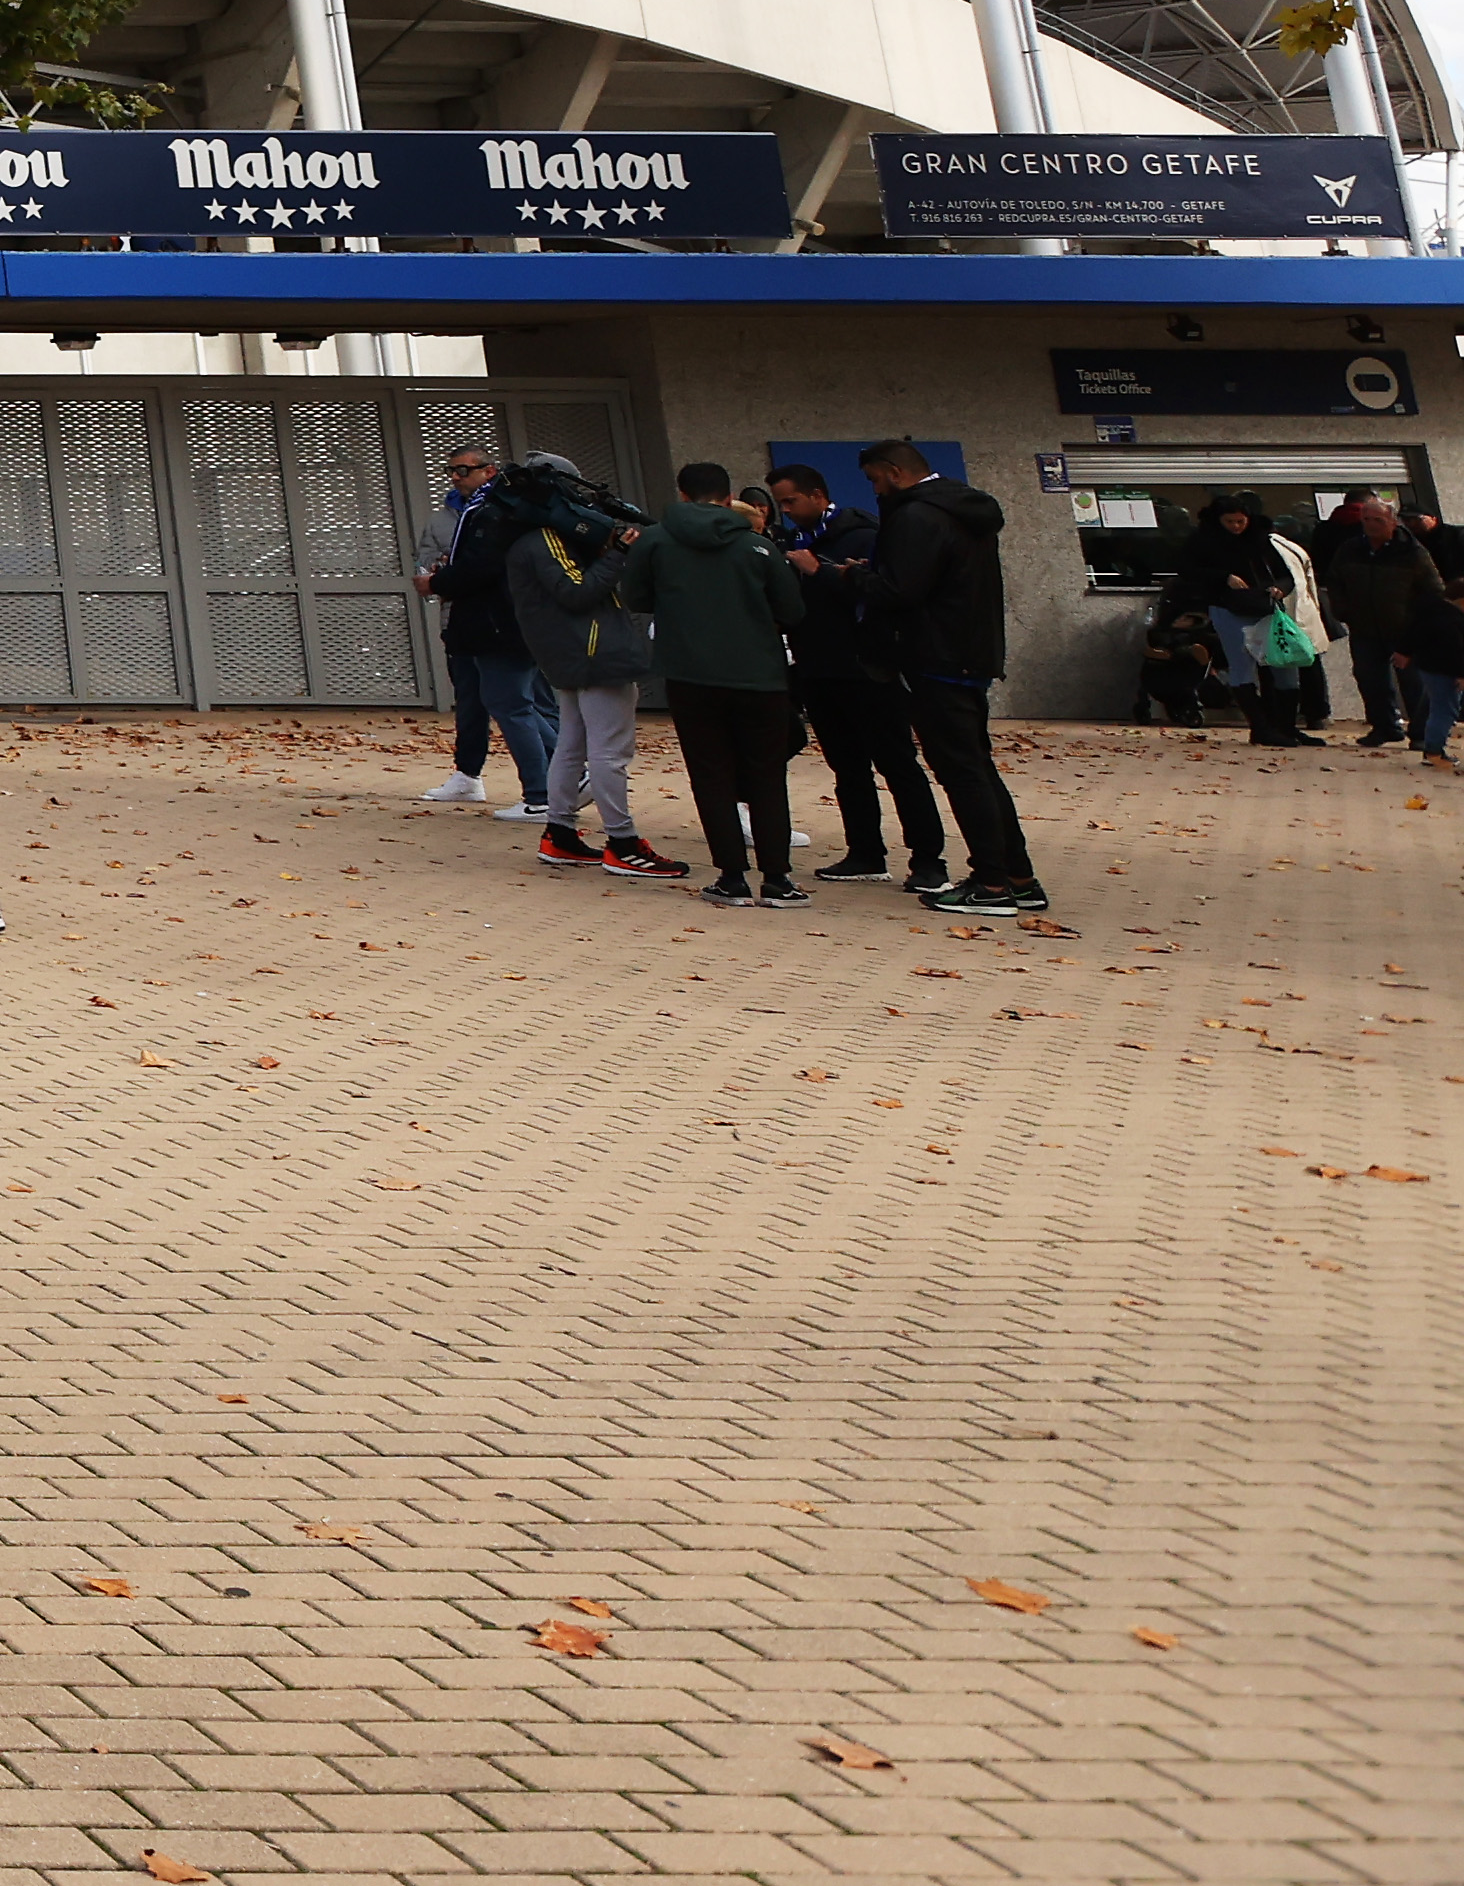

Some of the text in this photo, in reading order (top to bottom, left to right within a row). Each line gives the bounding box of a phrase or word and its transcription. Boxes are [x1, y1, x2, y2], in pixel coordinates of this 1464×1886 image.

[168, 137, 381, 189] Mahou
[479, 139, 691, 190] Mahou
[902, 153, 1262, 176] GRAN CENTRO GETAFE
[1001, 200, 1016, 210] DE
[1105, 201, 1123, 211] KM
[1181, 201, 1226, 211] GETAFE
[922, 213, 941, 223] 916
[1075, 368, 1136, 385] Taquillas
[1079, 383, 1152, 395] Tickets Office
